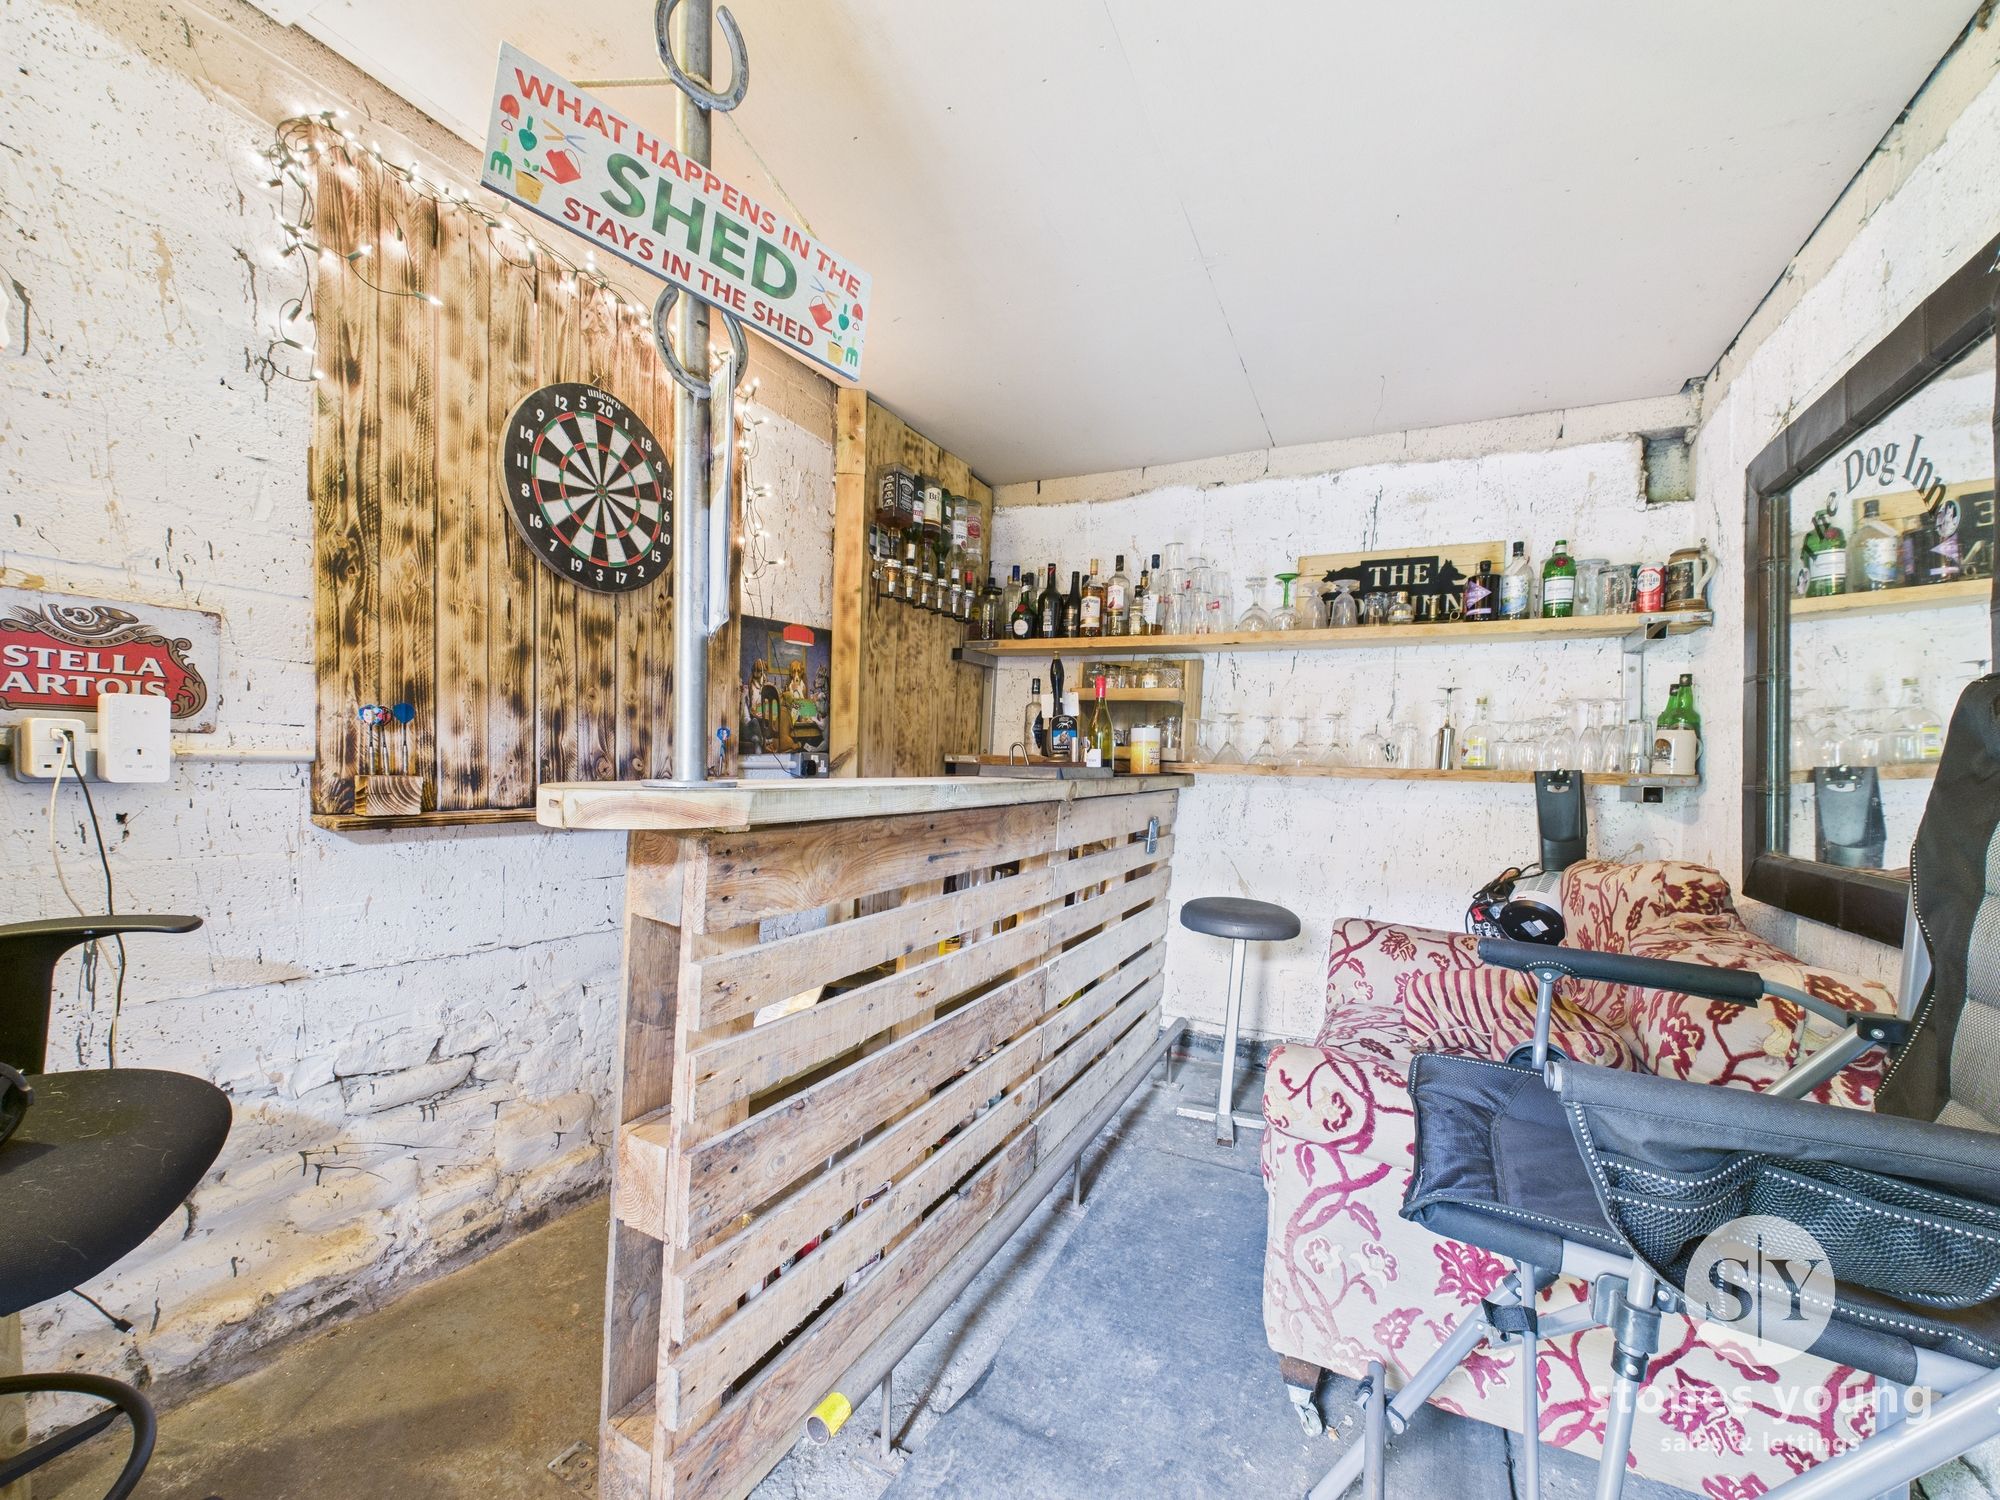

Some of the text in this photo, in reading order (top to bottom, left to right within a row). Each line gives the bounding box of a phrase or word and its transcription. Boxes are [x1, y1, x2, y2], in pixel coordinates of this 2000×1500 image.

[515, 67, 861, 298] WHAT HAPPENS IN THE
[600, 152, 798, 300] SHED
[563, 197, 814, 346] STAYS IN THE SHED
[555, 394, 568, 411] 12
[579, 396, 587, 409] 5
[587, 389, 621, 410] unicorn
[536, 409, 545, 421] 9
[597, 401, 614, 418] 20
[519, 425, 534, 443] 14
[640, 436, 652, 452] 18
[517, 454, 528, 469] 11
[655, 461, 662, 473] 4
[1843, 442, 1900, 494] Dog
[1902, 433, 1947, 515] Inn
[521, 483, 530, 497] 8
[662, 487, 673, 501] 13
[529, 513, 543, 529] 16
[664, 510, 670, 522] 6
[659, 529, 671, 545] 10
[550, 539, 558, 552] 7
[651, 547, 661, 563] 15
[570, 558, 583, 573] 19
[637, 565, 645, 578] 2
[596, 569, 604, 581] 3
[615, 569, 627, 584] 17
[1368, 563, 1430, 587] THE
[42, 625, 129, 646] ANNO 1366
[3, 645, 166, 677] STELLA
[0, 672, 167, 697] ARTOIS
